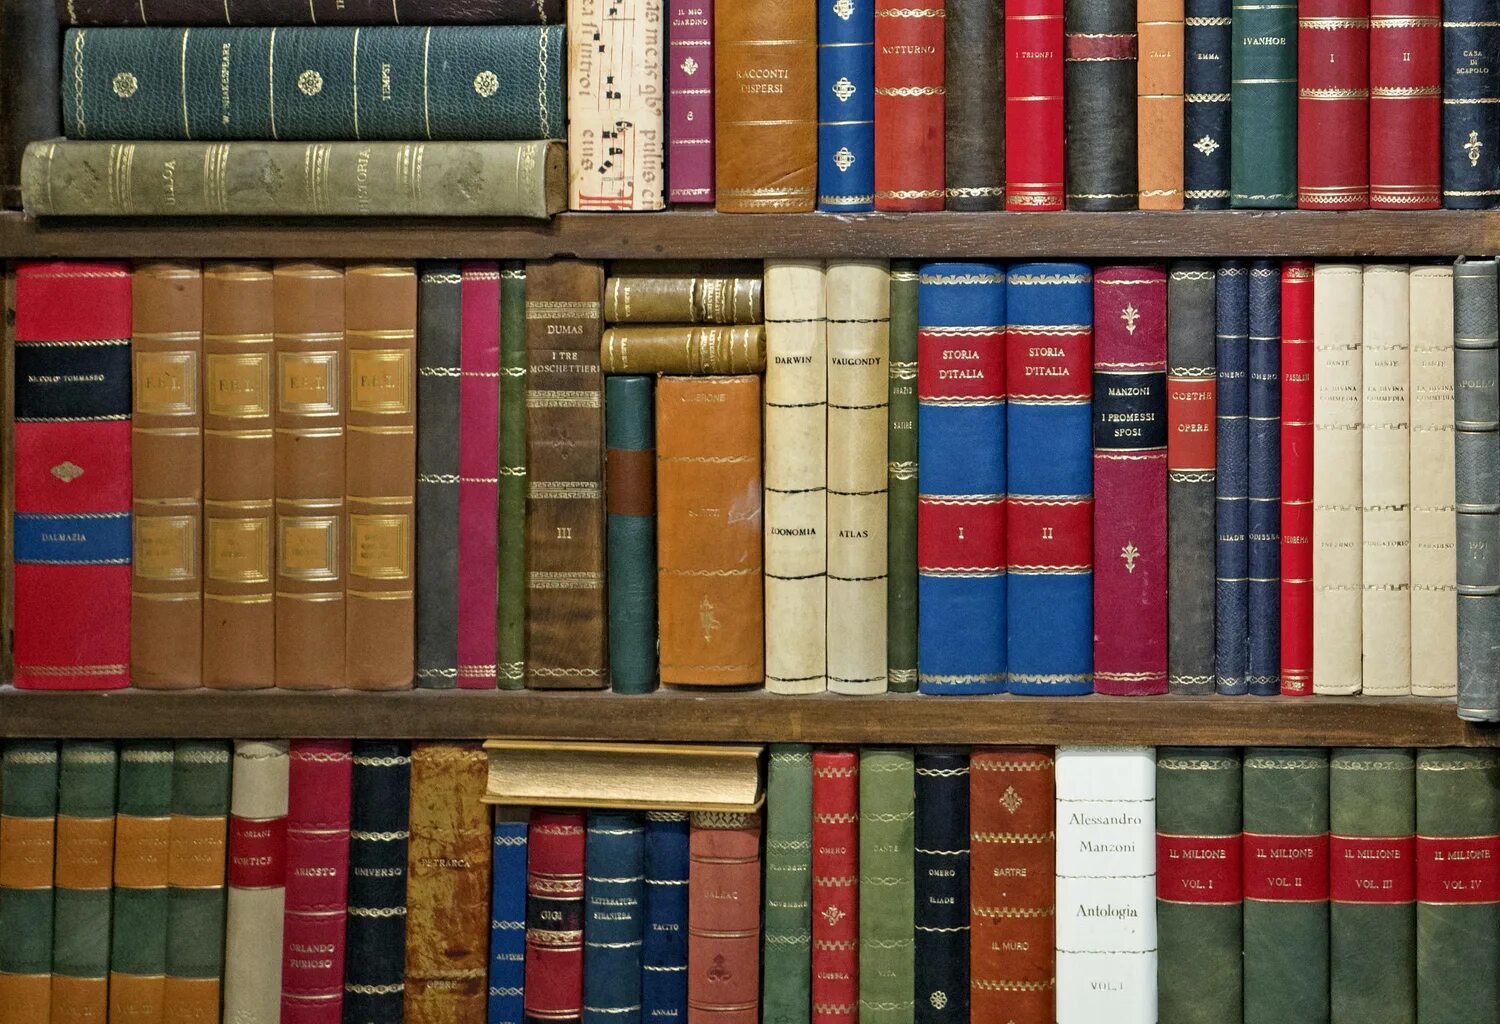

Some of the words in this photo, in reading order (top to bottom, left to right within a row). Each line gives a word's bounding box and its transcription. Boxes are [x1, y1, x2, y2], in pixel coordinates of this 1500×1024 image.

[1243, 36, 1286, 46] IVANHOE
[882, 46, 936, 55] NOTTURNO
[1463, 50, 1482, 58] CASA
[1402, 52, 1411, 62] II
[1456, 66, 1490, 74] SCAPOLO
[547, 325, 584, 335] DUMAS
[942, 350, 980, 361] STORIA
[1028, 347, 1065, 358] STORIA
[775, 356, 812, 365] DARWIN
[832, 356, 881, 366] VAUGONDY
[938, 368, 984, 380] D'ITALIA
[1025, 366, 1070, 377] D'ITALIA
[1108, 387, 1150, 396] MANZONI
[1172, 392, 1212, 401] GOETHE
[1102, 414, 1106, 422] I
[1108, 412, 1155, 422] PROMESSI
[1114, 428, 1142, 437] SPOSI
[1178, 424, 1210, 433] OPERE
[42, 532, 87, 542] DALMAZIA
[838, 530, 868, 539] ATLAS
[1042, 528, 1054, 540] II
[1068, 812, 1142, 826] Alessandro
[1079, 840, 1136, 854] Manzoni
[1169, 848, 1178, 859] IL
[1182, 849, 1227, 860] MILIONE
[1256, 848, 1266, 858] IL
[1269, 848, 1314, 860] MILIONE
[1344, 848, 1354, 859] IL
[1356, 849, 1401, 860] MILIONE
[1434, 850, 1444, 861] IL
[1446, 849, 1491, 861] MILIONE
[294, 867, 337, 876] ARIOSTO
[354, 867, 402, 877] UNIVERSO
[928, 869, 956, 877] OMERO
[993, 868, 1027, 877] SARTRE
[1181, 879, 1205, 889] VOL.
[1209, 879, 1212, 888] I
[1268, 877, 1292, 887] VOL.
[1295, 877, 1302, 887] II
[1356, 879, 1380, 889] VOL.
[1382, 879, 1392, 889] III
[1443, 880, 1469, 890] VOL.
[1472, 880, 1482, 890] IV
[540, 910, 562, 921] GIGI
[1076, 904, 1138, 920] Antologia
[992, 942, 1000, 951] IL
[1002, 942, 1030, 951] MURO
